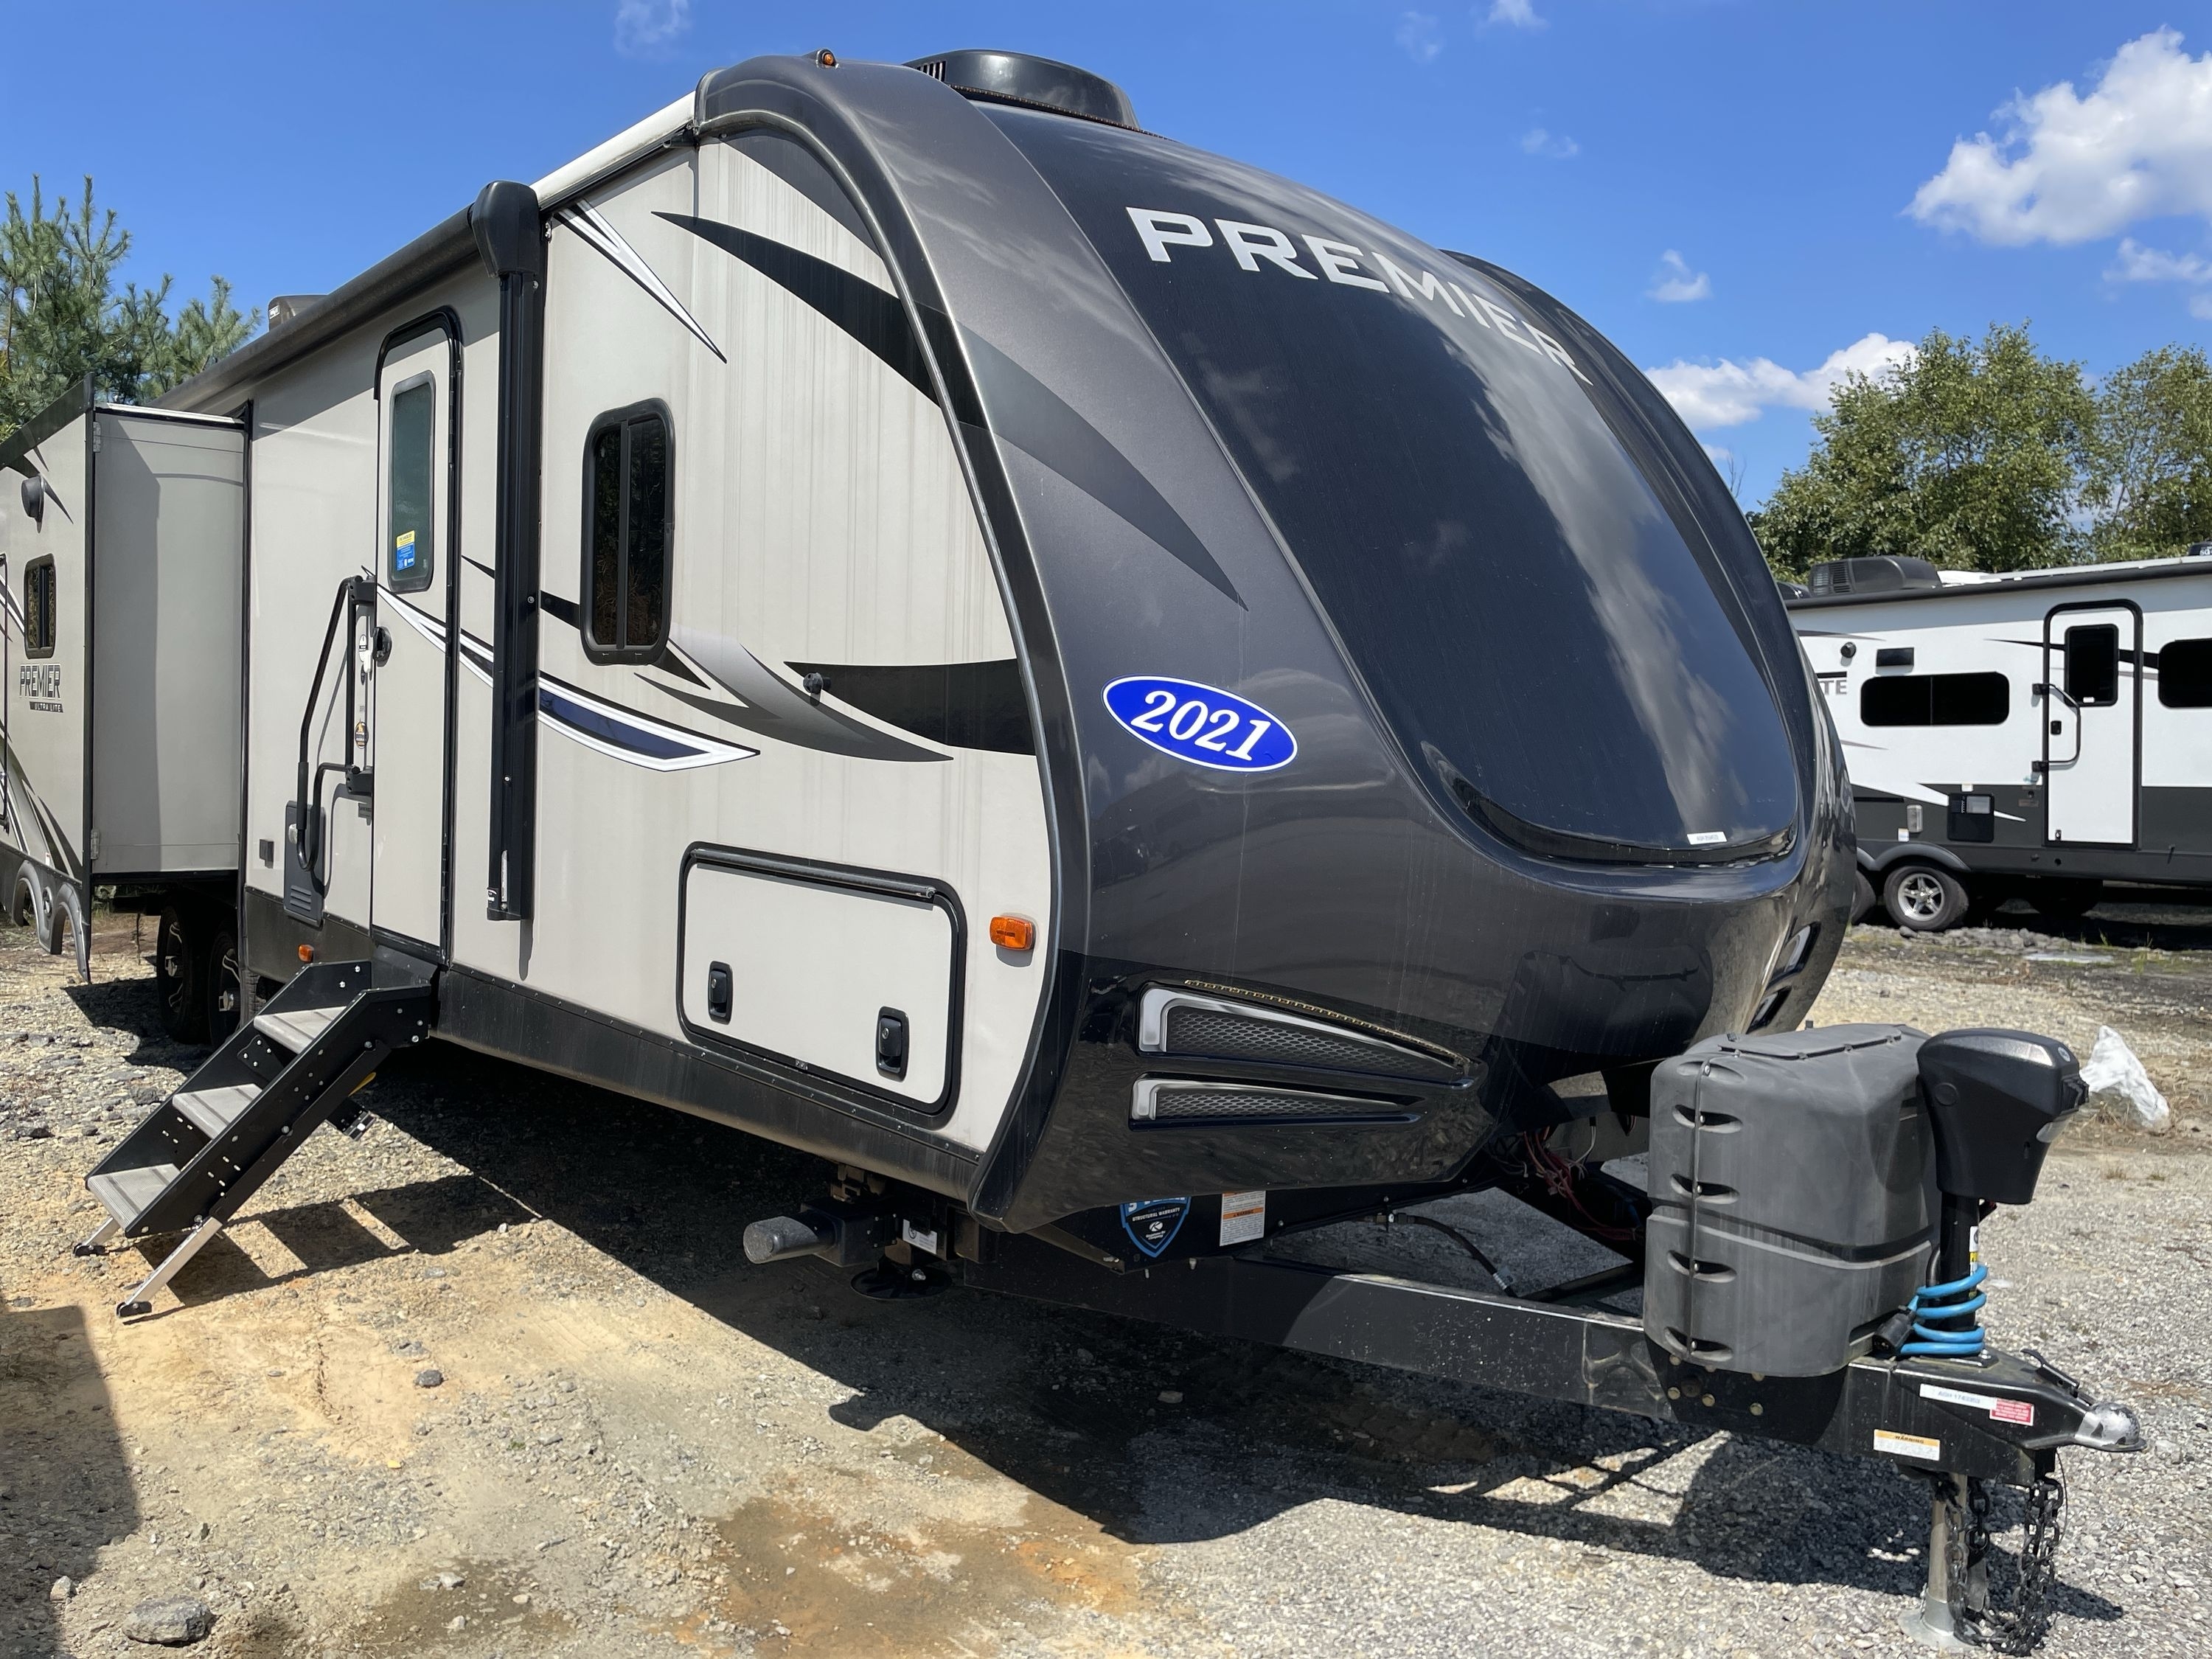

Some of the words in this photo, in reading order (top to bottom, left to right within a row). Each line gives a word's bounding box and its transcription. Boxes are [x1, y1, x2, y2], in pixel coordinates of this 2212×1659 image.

[1125, 206, 1594, 386] PREMIER
[19, 664, 61, 699] PREMIER
[34, 702, 49, 711] ULTRA
[50, 703, 61, 712] LITE
[1130, 690, 1271, 761] 2021
[1158, 1207, 1180, 1216] WARRANTY
[1895, 1435, 1924, 1444] WARNING
